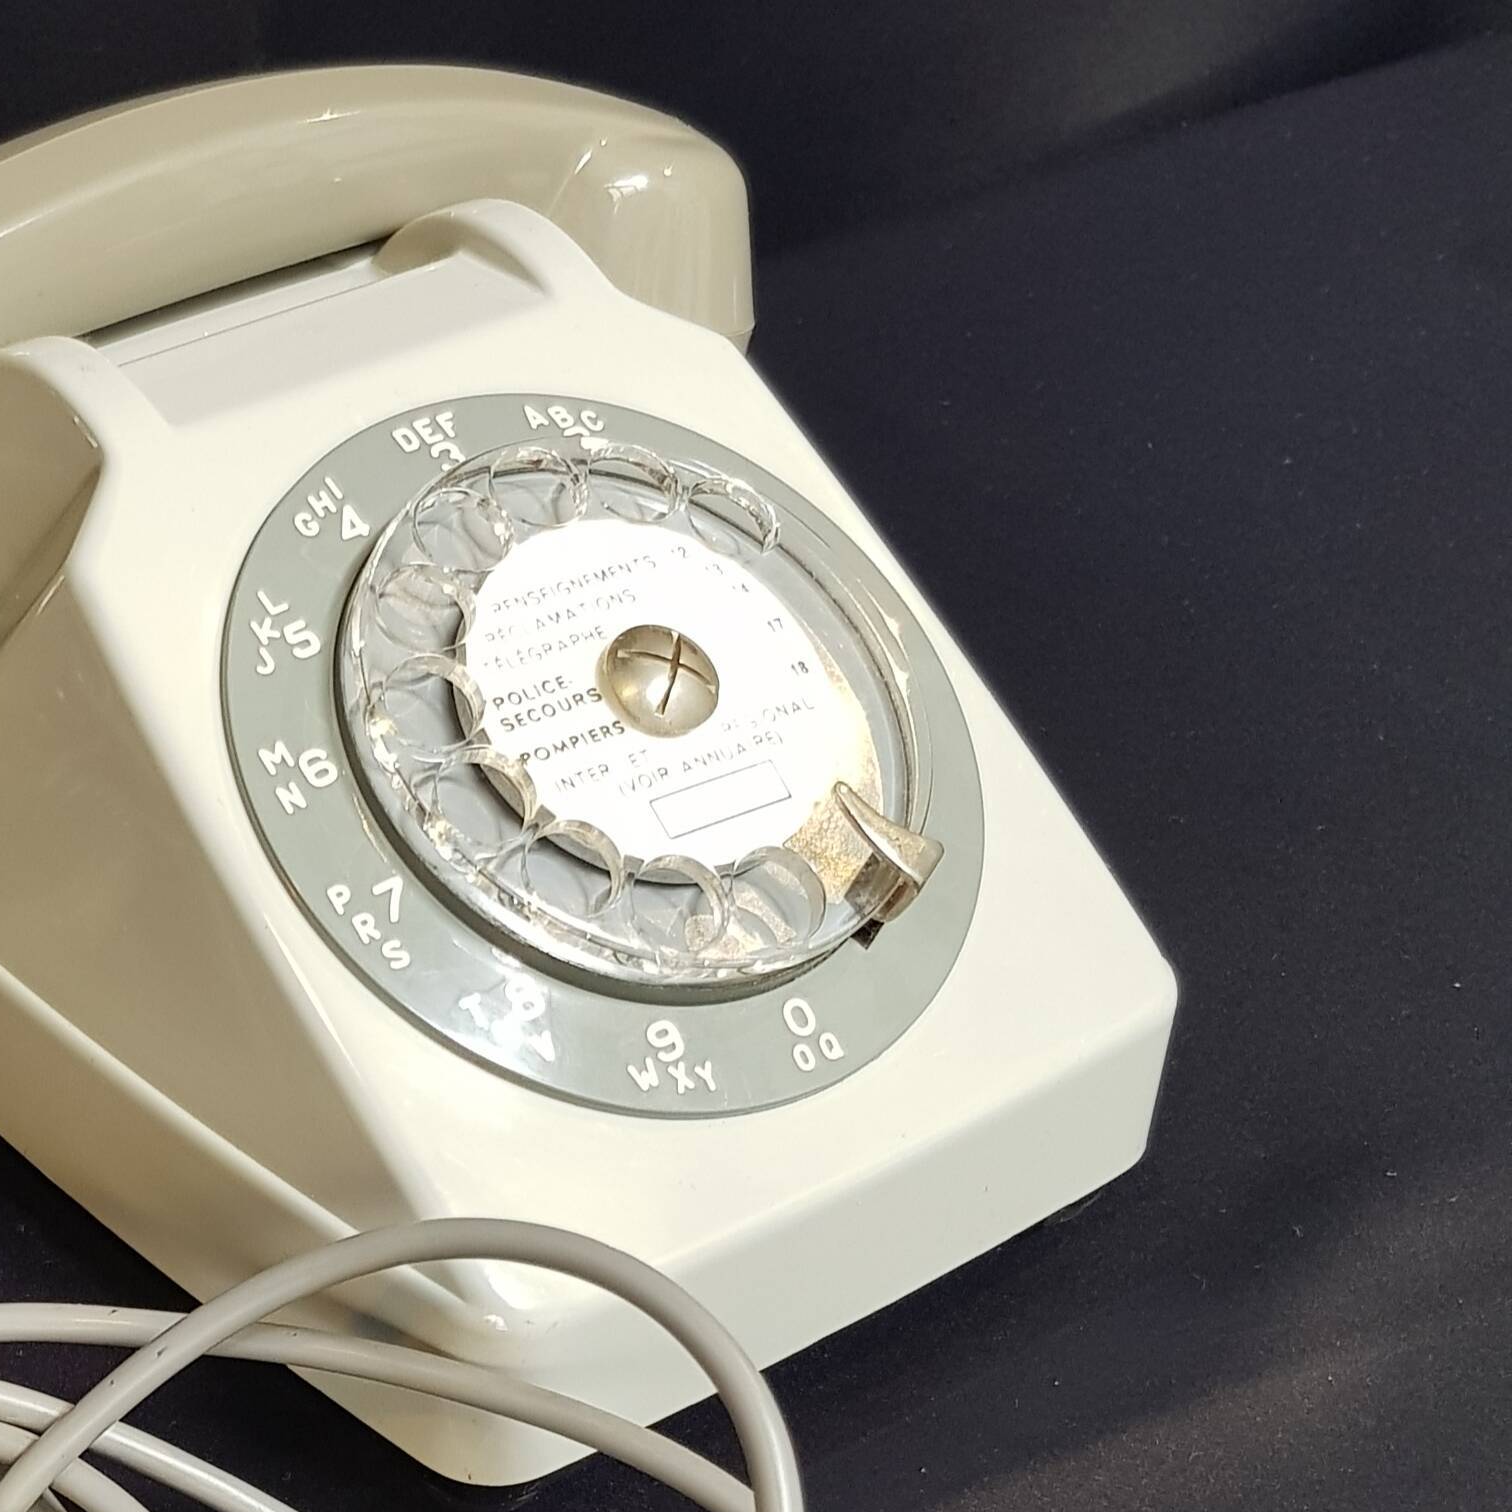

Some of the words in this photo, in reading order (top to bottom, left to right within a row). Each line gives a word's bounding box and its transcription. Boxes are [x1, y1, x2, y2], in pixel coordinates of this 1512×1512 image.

[391, 411, 456, 452] DEF
[523, 405, 604, 431] ABC
[293, 477, 343, 537] GHI
[341, 504, 370, 541] 4
[670, 546, 687, 560] 2
[283, 619, 321, 659] 5
[767, 618, 784, 632] 17
[500, 687, 603, 732] SECOURS
[519, 720, 625, 766] POMPIERS
[790, 661, 809, 676] 18
[298, 749, 338, 788] 6
[682, 731, 785, 773] ANNUARE)
[554, 764, 609, 793] INTER
[372, 875, 404, 923] 7
[646, 1019, 685, 1063] 9
[627, 1056, 717, 1094] WXY
